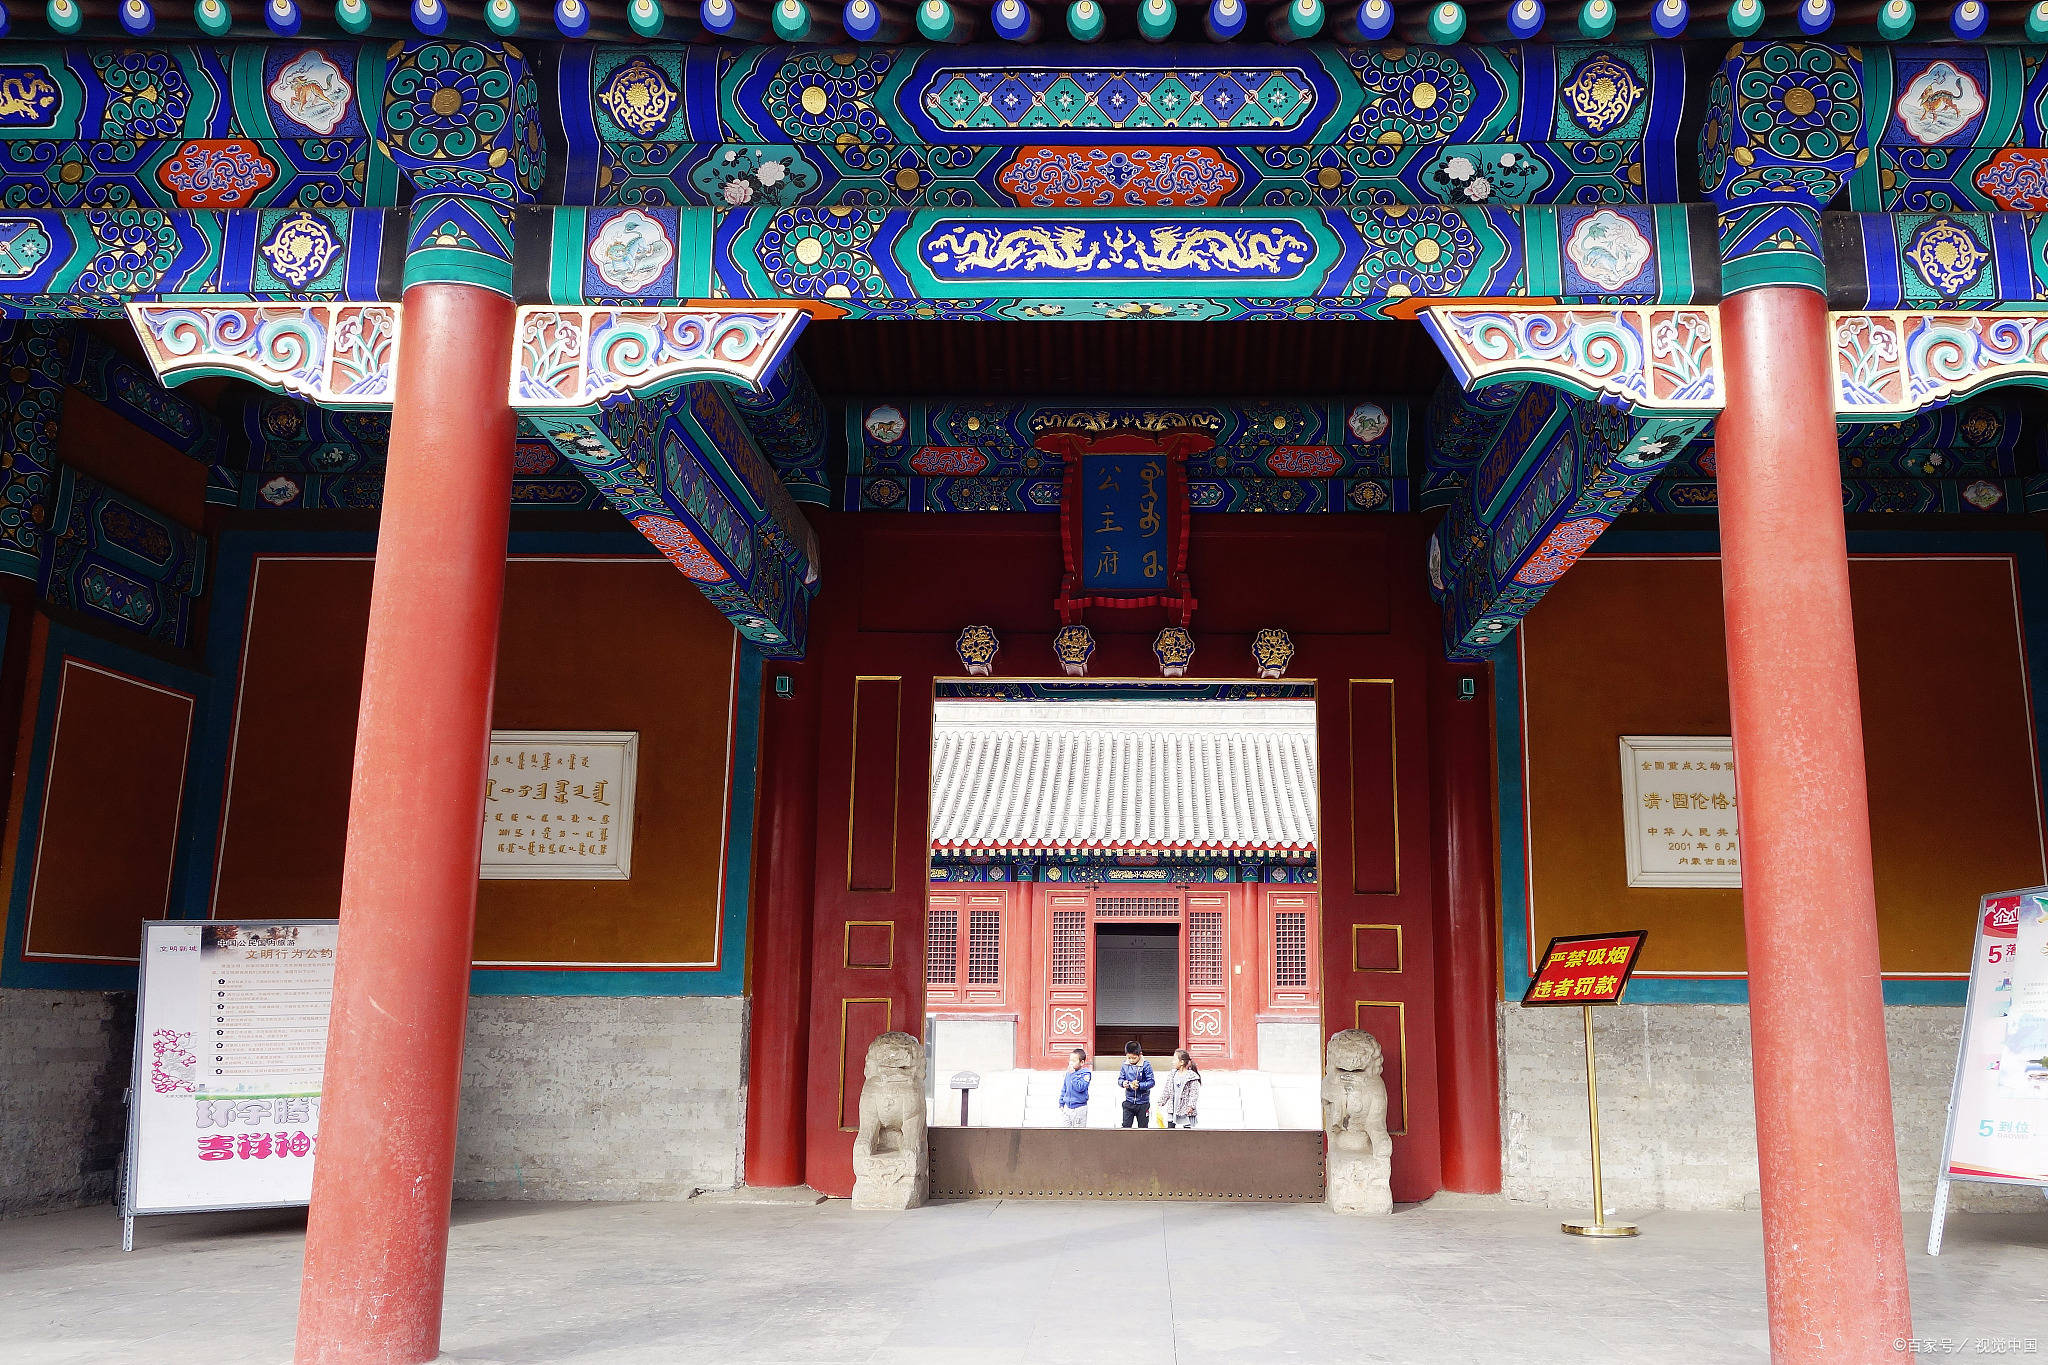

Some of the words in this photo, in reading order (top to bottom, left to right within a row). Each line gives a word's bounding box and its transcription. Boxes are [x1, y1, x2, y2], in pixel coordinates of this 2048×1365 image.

[1094, 465, 1123, 578] 公主府
[245, 948, 333, 960] 文明行为公约
[1544, 946, 1631, 970] 严禁吸烟
[1988, 945, 2003, 964] 5
[1533, 975, 1619, 998] 违者罚款
[196, 1097, 322, 1128] 环宇腾
[1979, 1119, 1994, 1137] 5
[1999, 1121, 2030, 1134] 到位
[197, 1130, 318, 1161] 吉祥神
